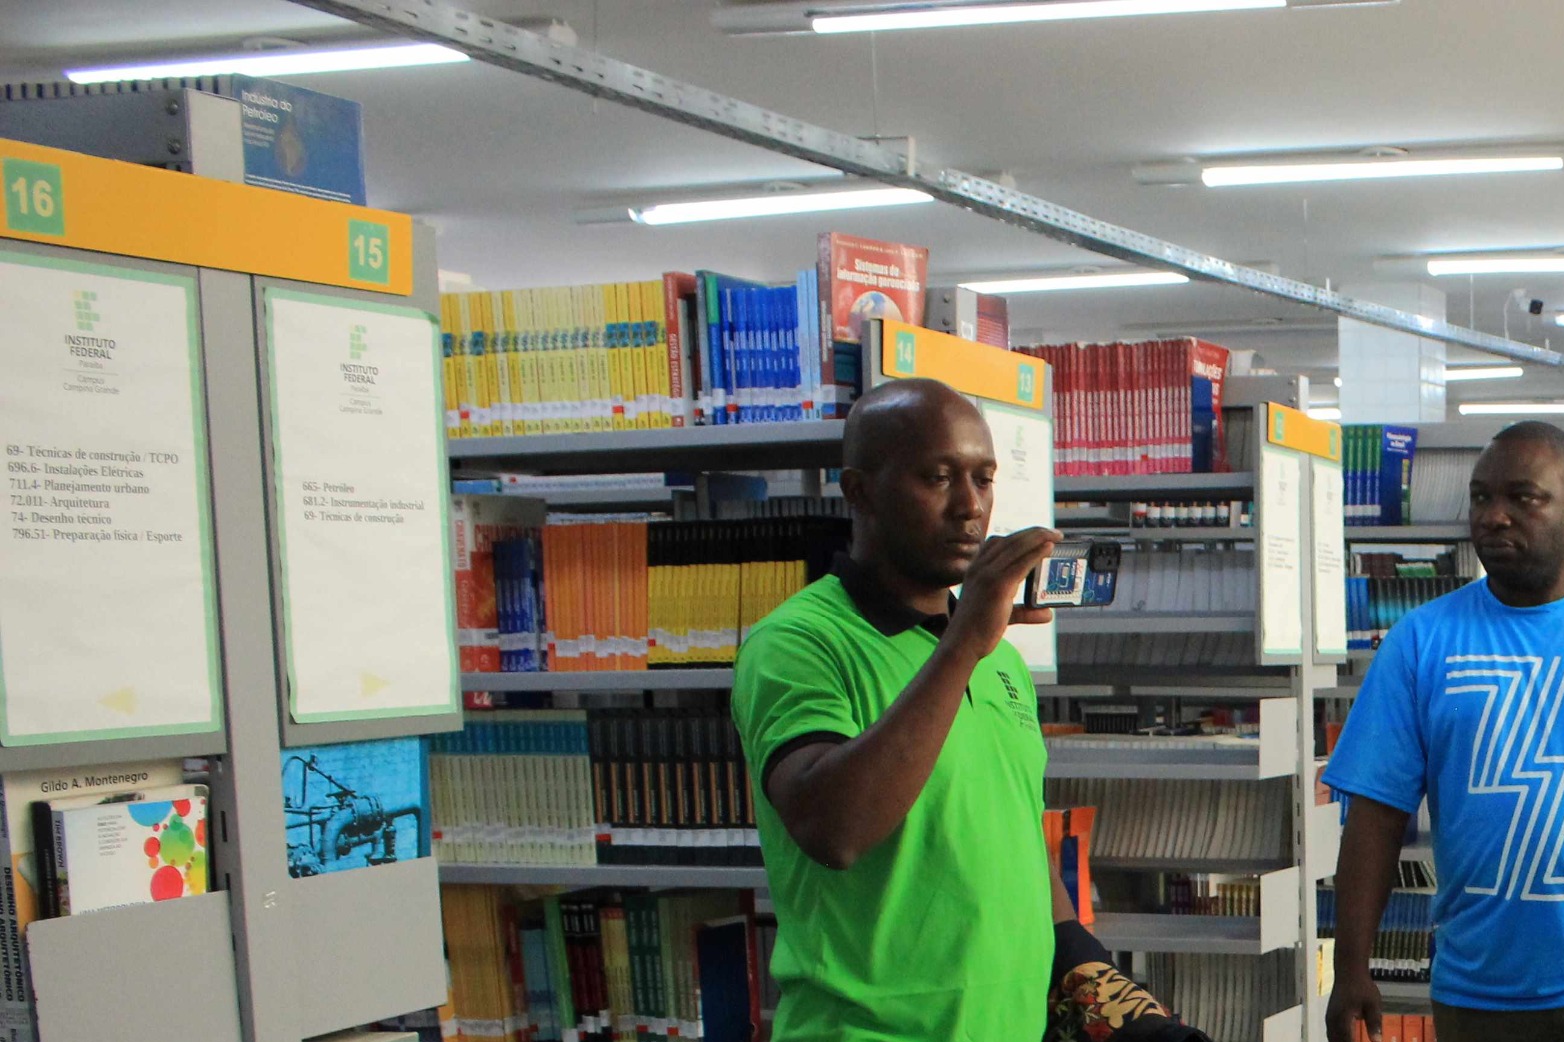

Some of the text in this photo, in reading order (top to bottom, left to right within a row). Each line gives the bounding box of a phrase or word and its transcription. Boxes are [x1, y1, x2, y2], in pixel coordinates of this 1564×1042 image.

[12, 177, 55, 217] 16
[353, 234, 384, 268] 15
[65, 334, 116, 350] INSTITUTO
[70, 345, 113, 360] FEDERAL
[897, 340, 913, 364] 14
[340, 362, 380, 376] INSTITUTO
[344, 372, 376, 385] FEDERAL
[1020, 371, 1032, 393] 13
[27, 445, 73, 459] Técnicas
[75, 449, 87, 460] de
[89, 450, 141, 464] construção
[149, 452, 180, 464] TCPO
[44, 462, 99, 477] Instalações
[101, 466, 145, 478] Elétricas
[44, 479, 112, 494] Planejamento
[114, 483, 150, 495] urbano
[50, 495, 111, 510] Arquitetura
[31, 511, 75, 524] Desenho
[77, 512, 112, 525] técnico
[52, 528, 112, 543] Preparação
[146, 531, 183, 545] Esporte
[40, 771, 150, 793] Gildo A. Montenegro
[4, 866, 25, 1003] DESENHO ARQUITETÔNICO
